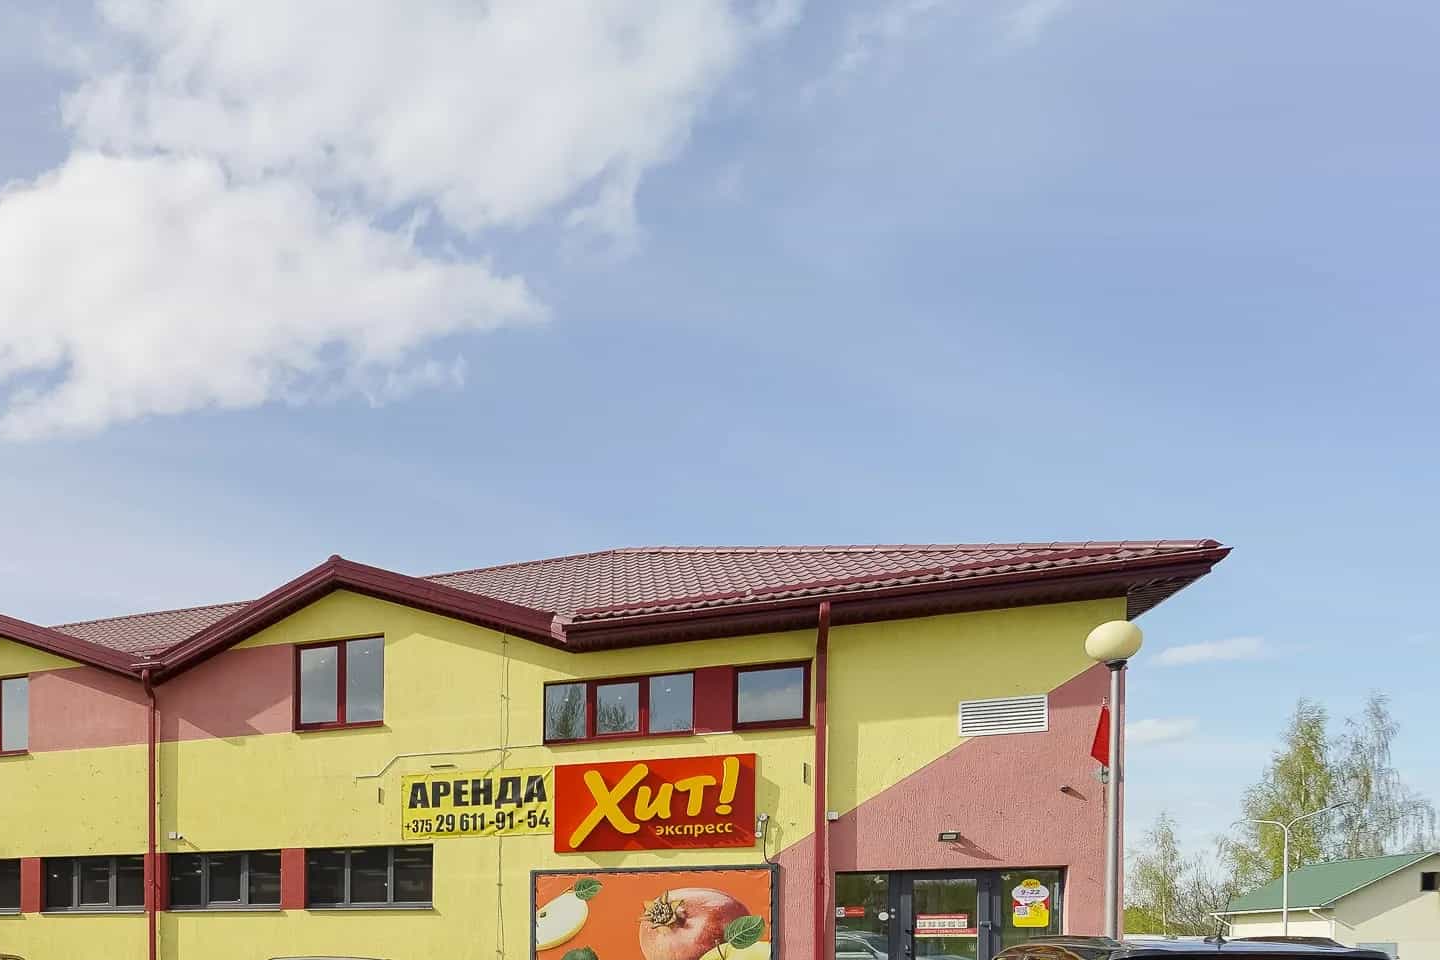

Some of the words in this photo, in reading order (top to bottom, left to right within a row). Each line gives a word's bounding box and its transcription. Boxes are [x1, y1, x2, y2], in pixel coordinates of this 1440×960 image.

[408, 774, 547, 810] АРЕНДА
[569, 756, 740, 849] Хит!
[404, 819, 433, 834] +375
[435, 814, 455, 833] 29
[654, 823, 734, 837] экспресс
